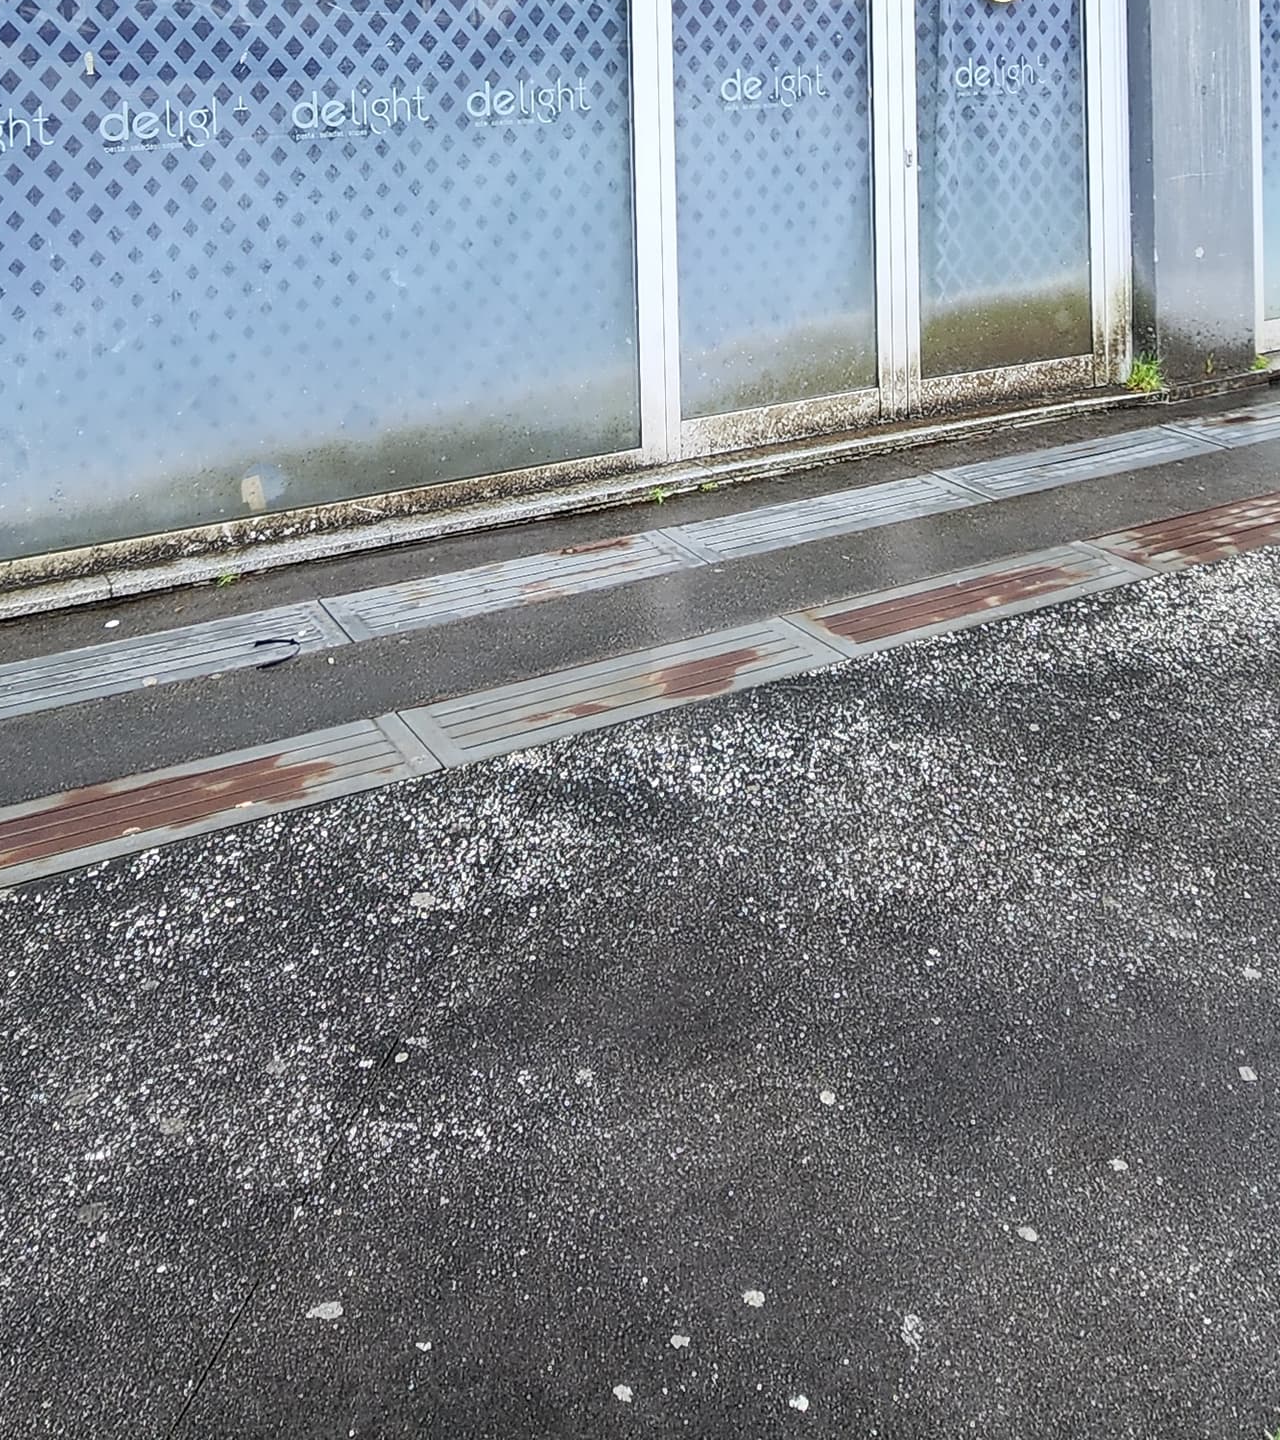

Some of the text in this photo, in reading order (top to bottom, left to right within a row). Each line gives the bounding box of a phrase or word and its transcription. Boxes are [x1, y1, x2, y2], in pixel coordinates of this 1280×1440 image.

[466, 76, 592, 124] delight
[721, 63, 827, 108] deight
[291, 86, 430, 135] delight
